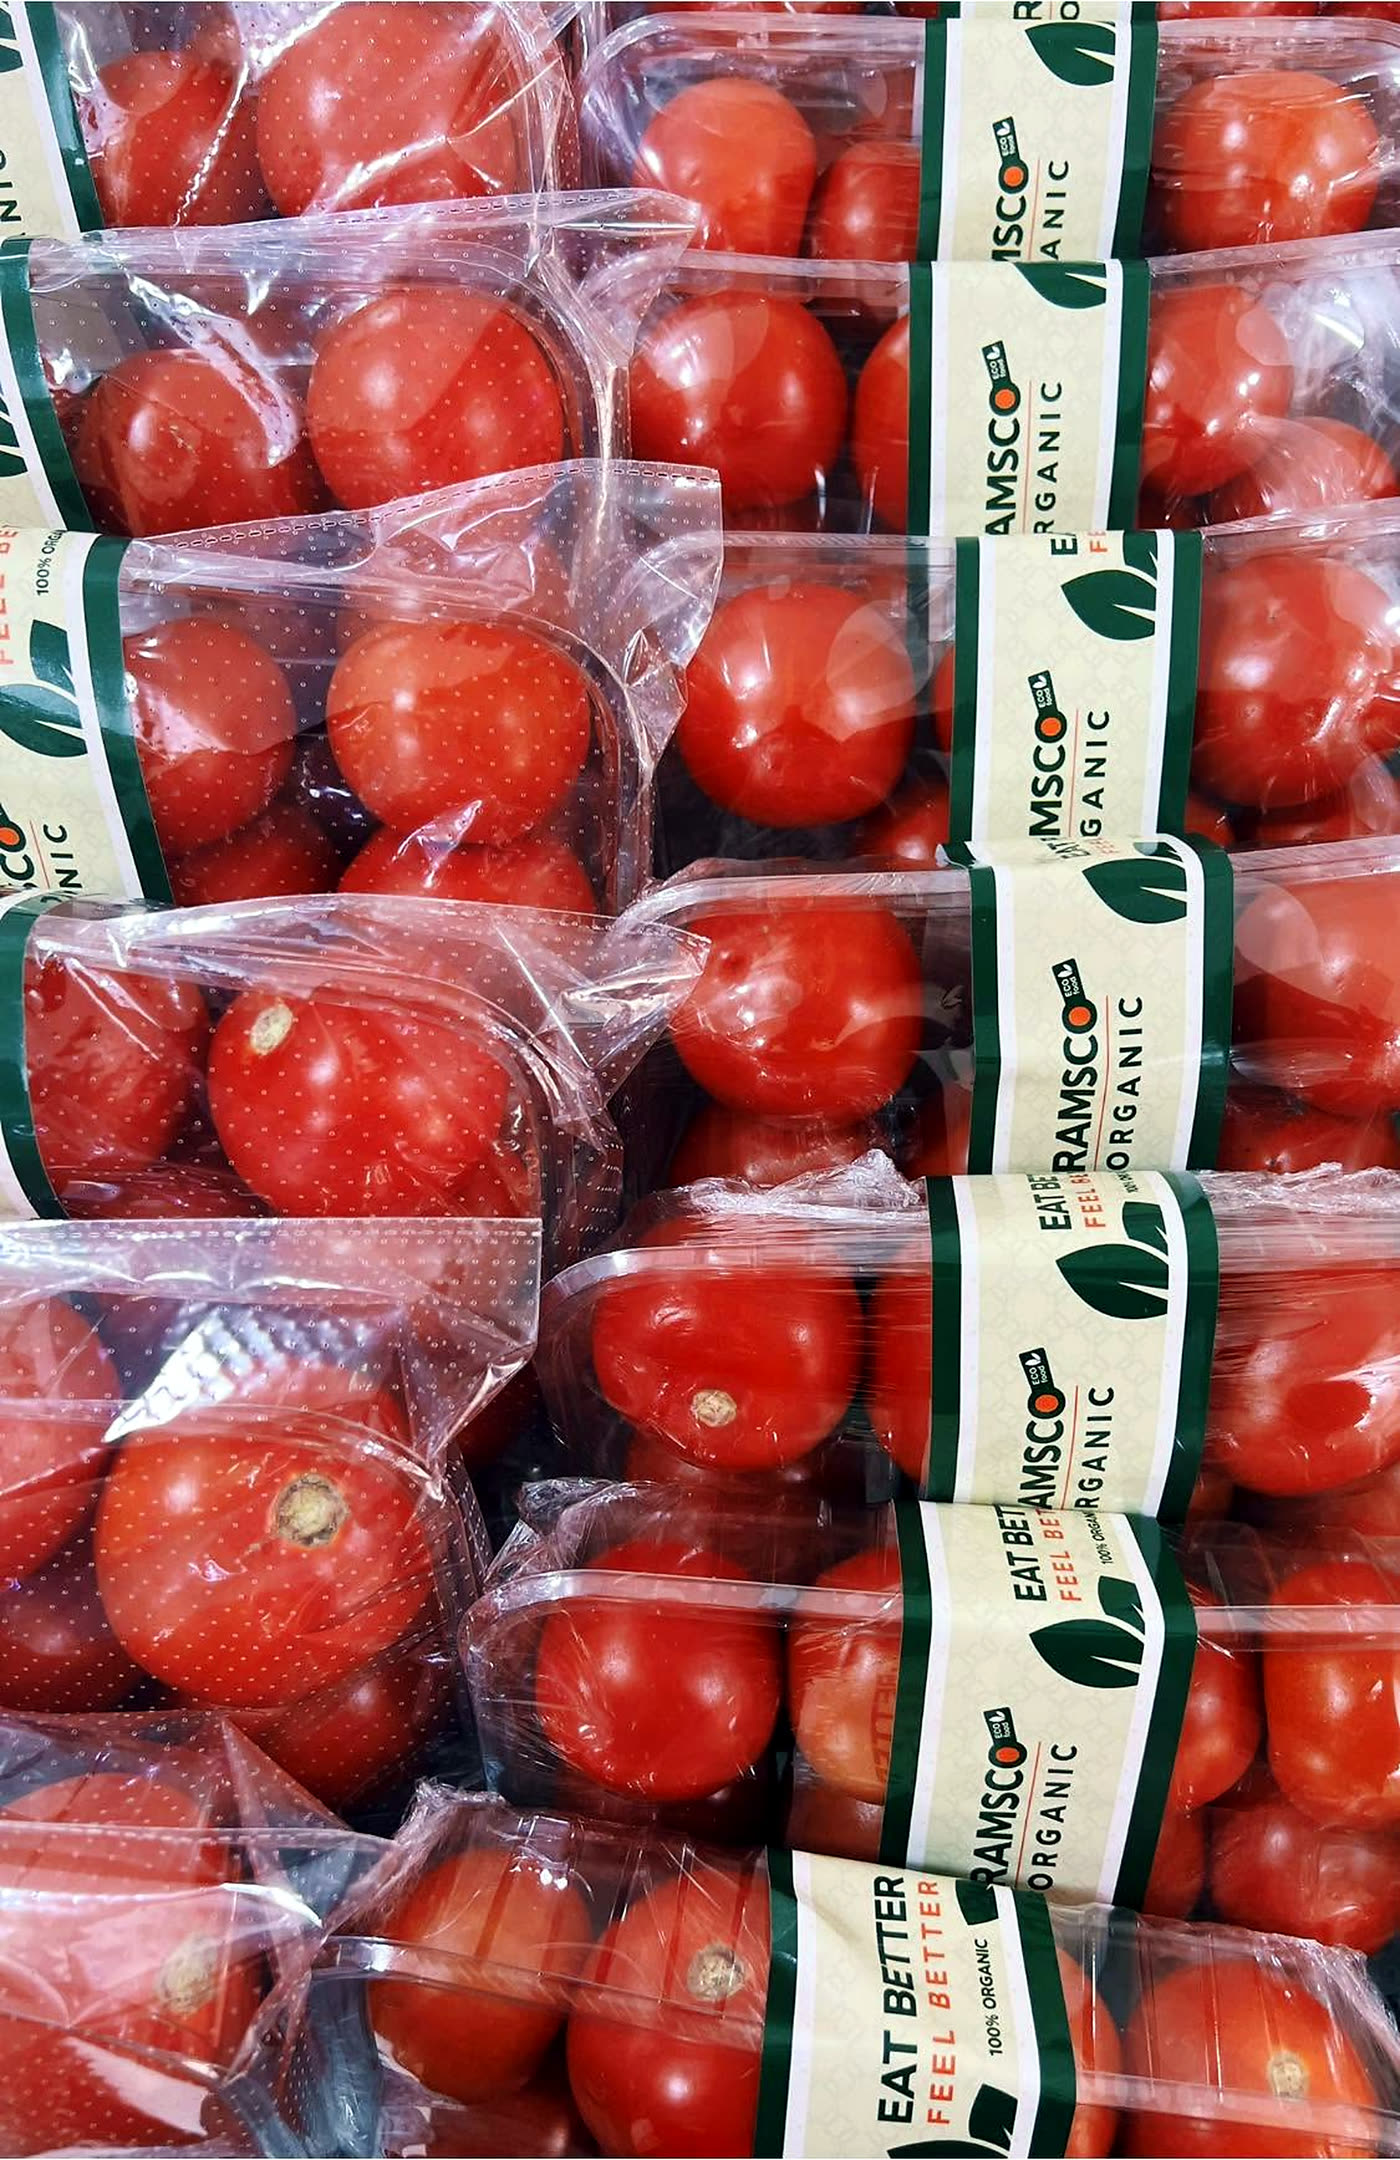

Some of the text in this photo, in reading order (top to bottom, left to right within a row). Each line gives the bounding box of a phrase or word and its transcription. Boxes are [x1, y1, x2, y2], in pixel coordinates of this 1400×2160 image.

[985, 382, 1021, 535] AMSCO
[36, 557, 52, 596] 100%
[1028, 711, 1068, 836] MSCO
[1079, 711, 1110, 837] GANIC
[43, 824, 82, 896] NIC
[1061, 978, 1073, 998] ECO
[1052, 1000, 1099, 1172] RAMSCO
[1105, 996, 1143, 1171] ORGANIC
[1033, 1194, 1073, 1230] EAT
[1075, 1188, 1106, 1227] FEEL
[1029, 1367, 1040, 1386] ECO
[1038, 1366, 1048, 1384] food
[1017, 1387, 1066, 1509] AMSCO
[1074, 1387, 1114, 1508] RGANIC
[1005, 1551, 1047, 1601] EAT
[1049, 1550, 1082, 1601] FEEL
[1095, 1543, 1113, 1564] 100%
[992, 1723, 1003, 1739] ECO
[1028, 1744, 1077, 1890] ORGANIC
[873, 1875, 918, 2123] EAT BETTER
[918, 1880, 956, 2125] FEEL BETTER
[974, 1938, 1002, 2056] 100% ORGANIC
